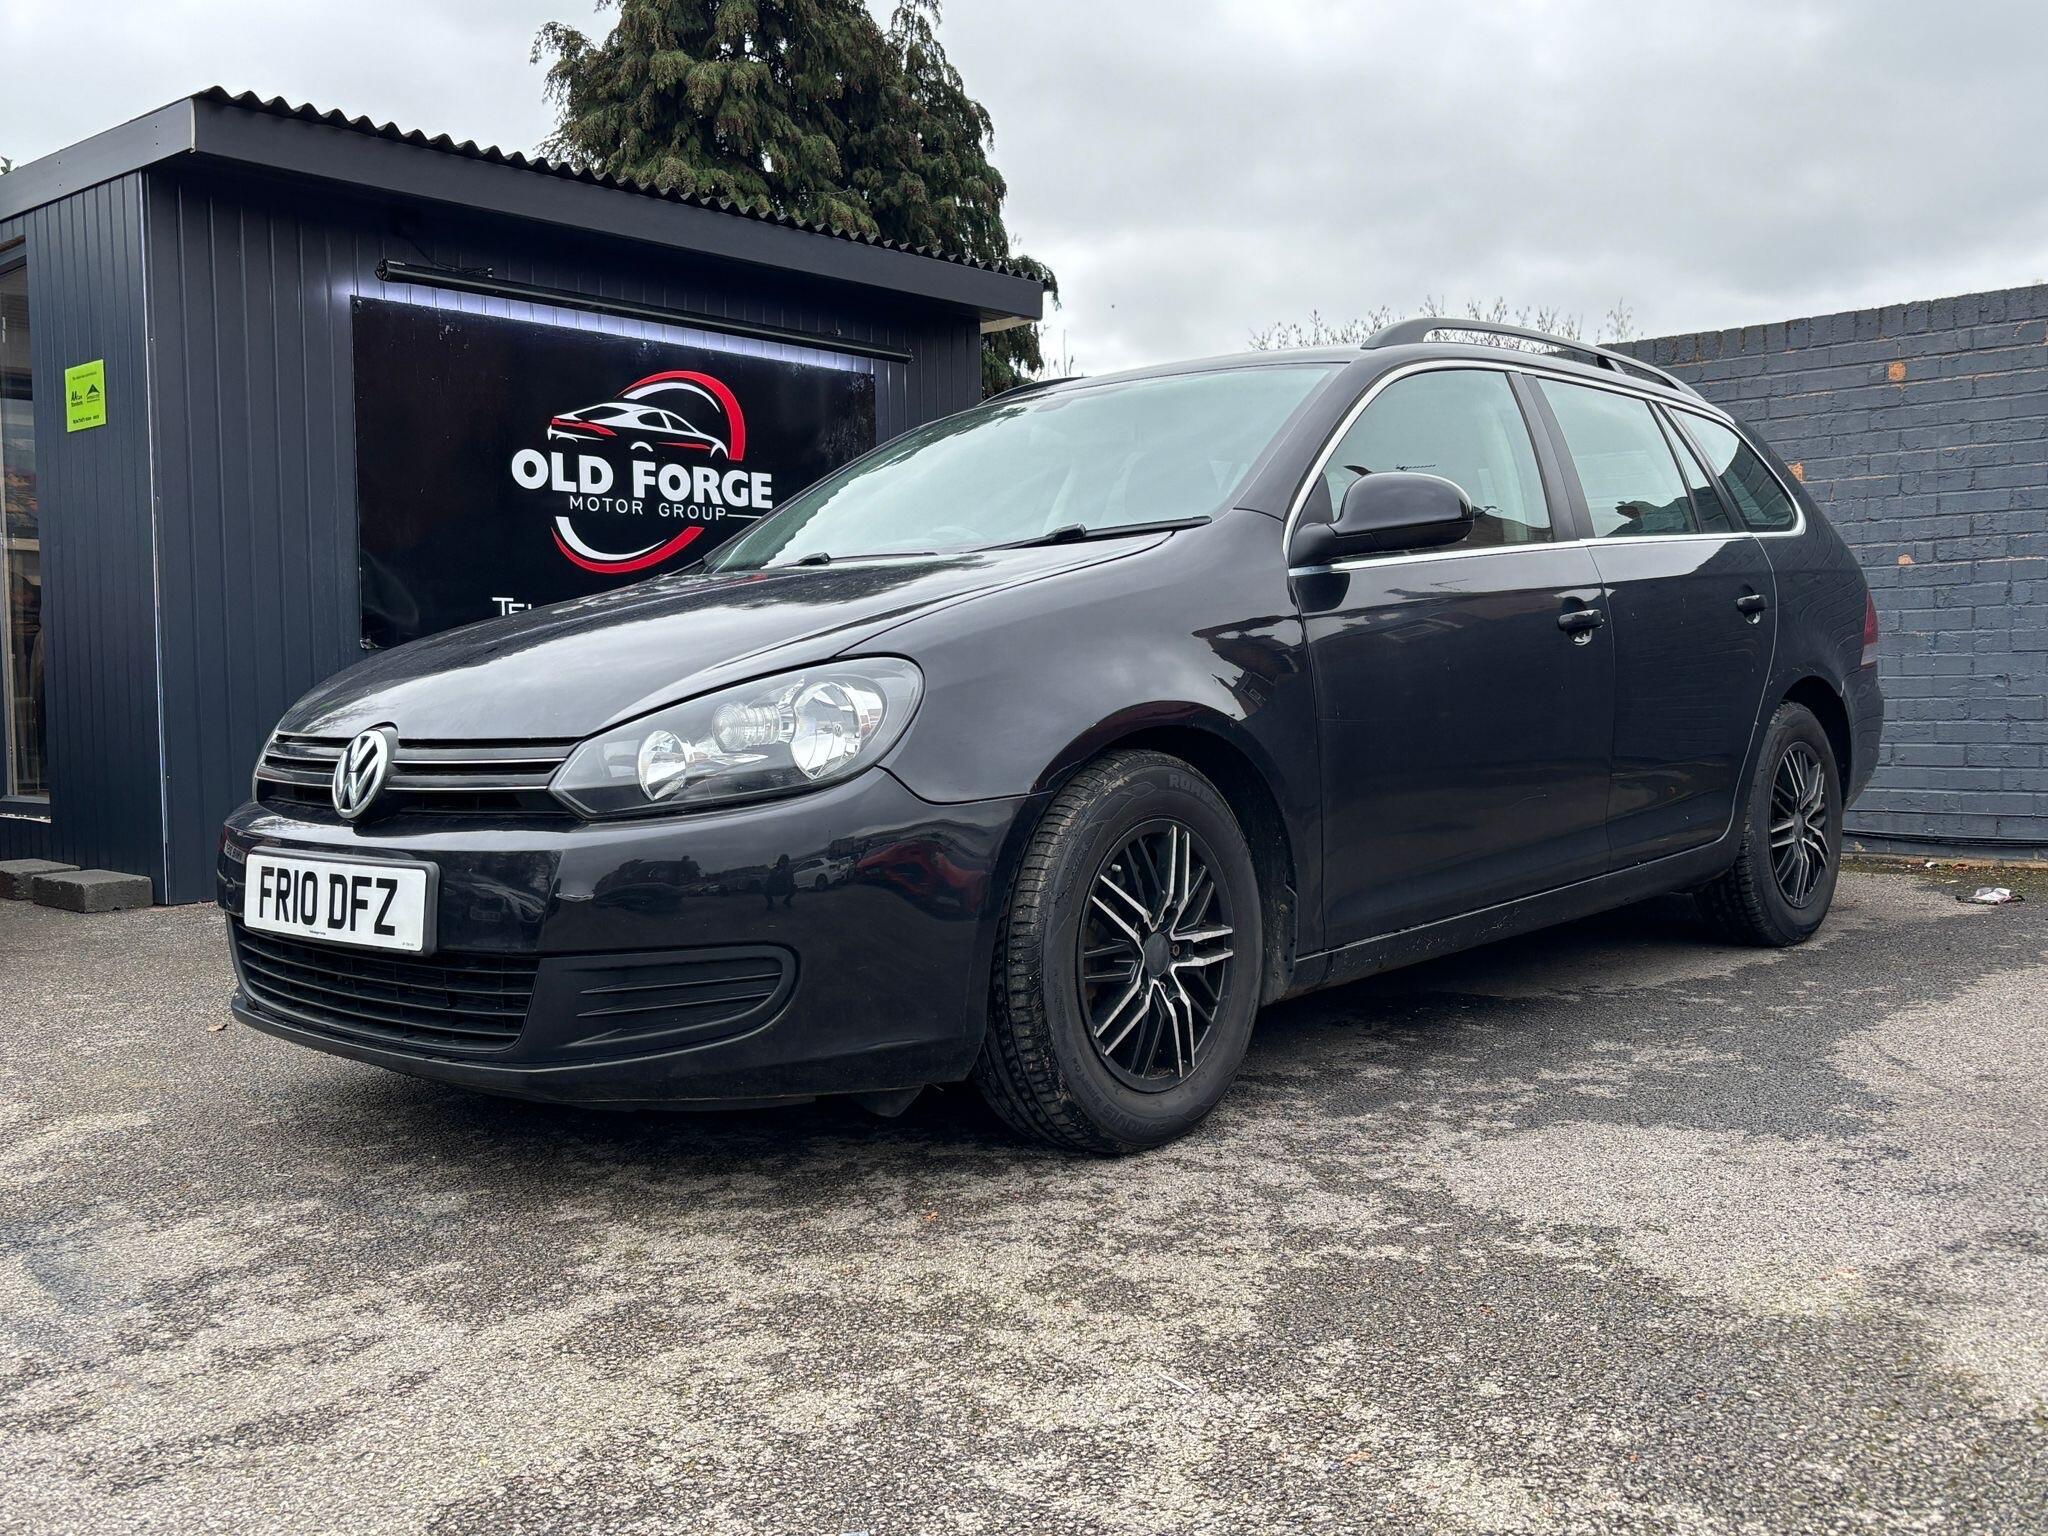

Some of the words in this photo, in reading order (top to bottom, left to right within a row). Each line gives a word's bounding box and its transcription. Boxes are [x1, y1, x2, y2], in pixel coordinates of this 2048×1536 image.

[511, 448, 614, 494] OLD
[633, 460, 773, 509] FORGE
[569, 495, 643, 516] MOTOR
[659, 502, 727, 522] GROUP
[258, 865, 318, 926] FR10
[327, 873, 398, 936] DFZ
